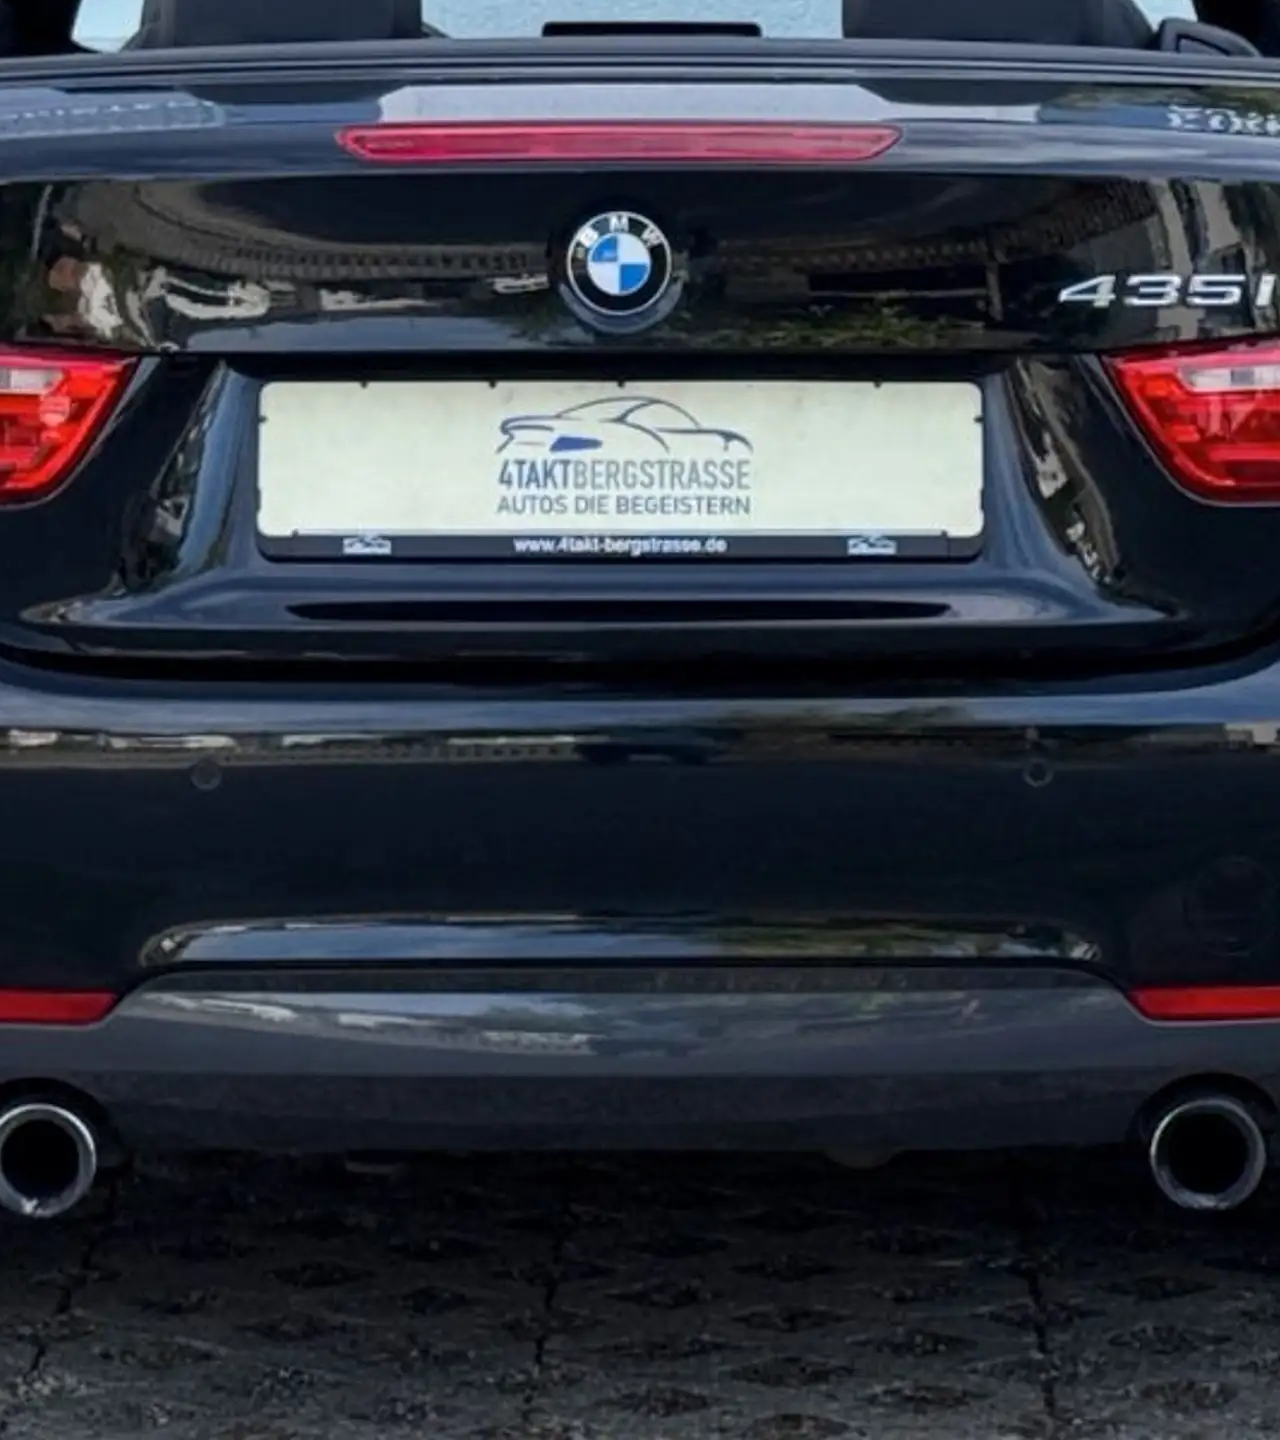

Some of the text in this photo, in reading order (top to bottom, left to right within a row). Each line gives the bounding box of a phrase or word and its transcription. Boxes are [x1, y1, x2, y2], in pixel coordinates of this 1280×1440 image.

[579, 214, 664, 249] BMW
[498, 459, 751, 490] 4TAKTBERGSTRASSE
[497, 495, 751, 516] AUTOS DIE BEGEISTERN
[514, 536, 728, 557] www.4takt-bergstrasse.de
